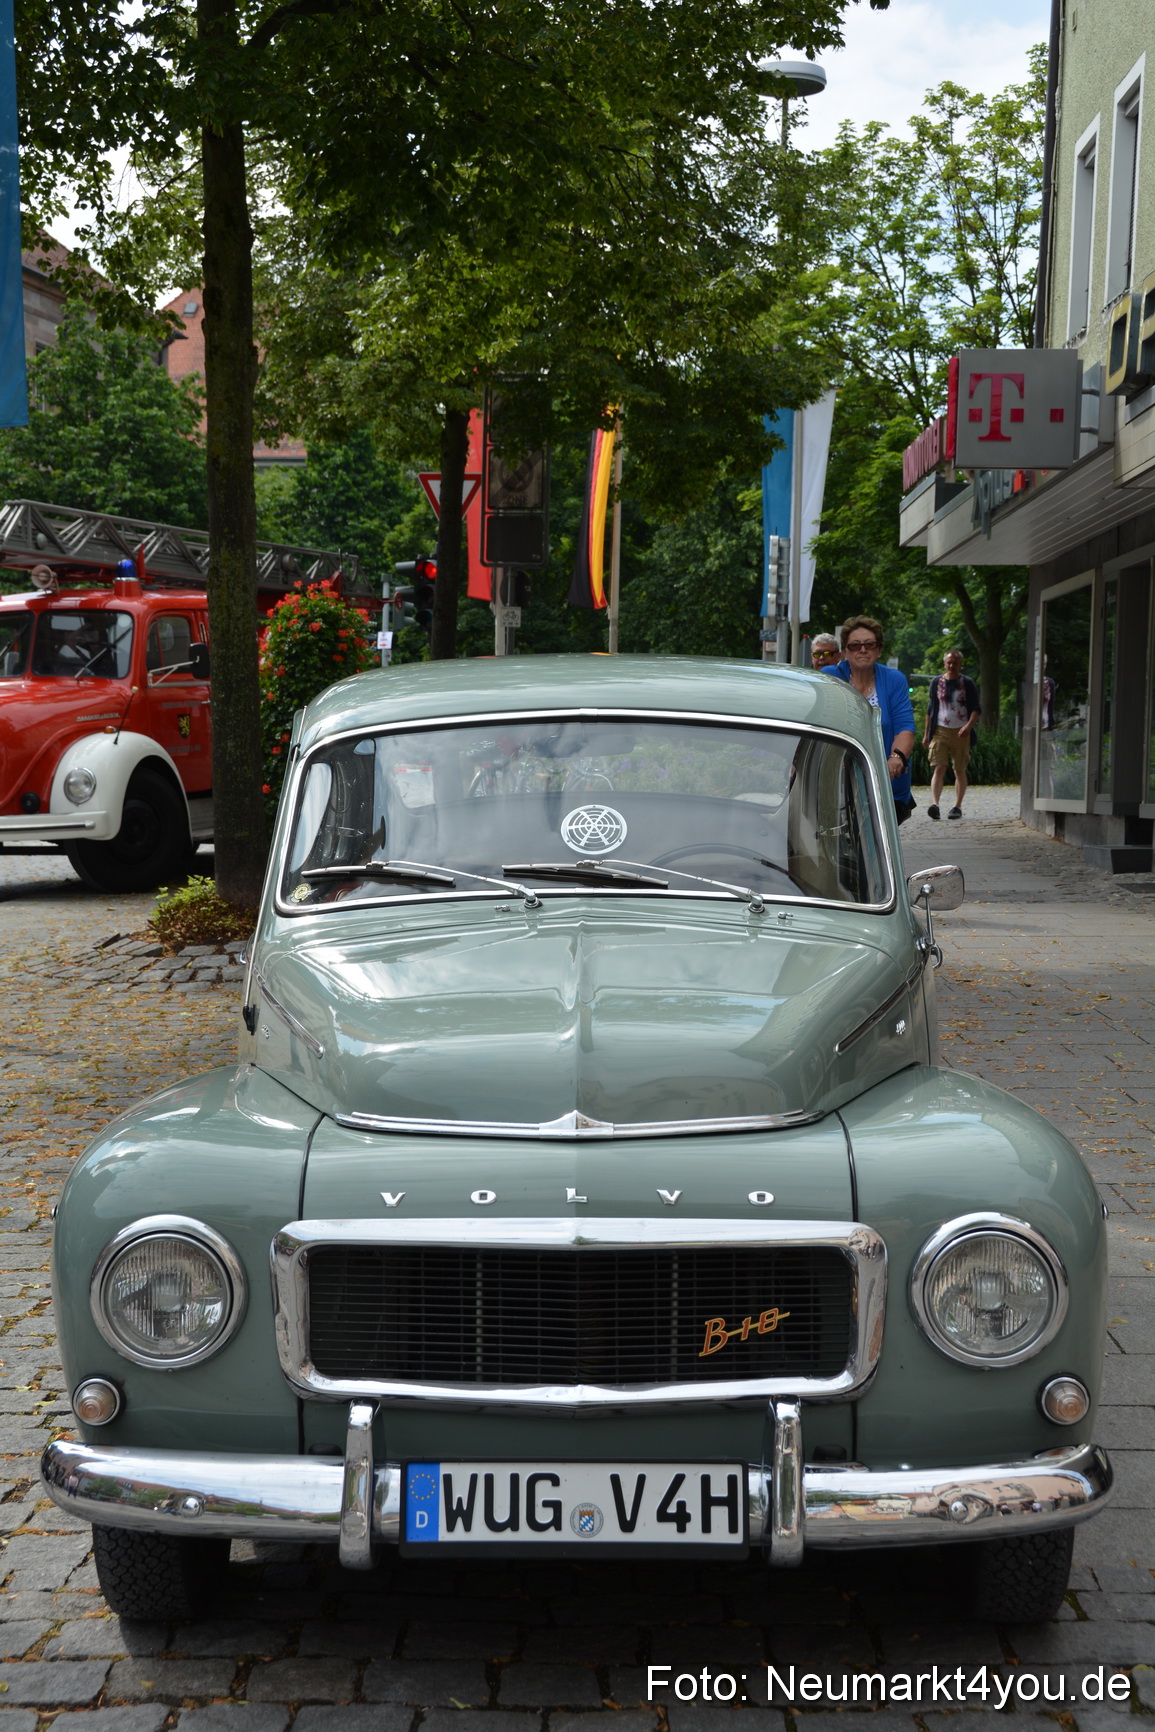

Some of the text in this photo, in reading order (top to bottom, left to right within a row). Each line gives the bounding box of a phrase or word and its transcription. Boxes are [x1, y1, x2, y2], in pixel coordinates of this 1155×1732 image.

[380, 1187, 775, 1208] VOLVO
[415, 1510, 429, 1529] D
[442, 1472, 563, 1533] WUG
[609, 1473, 739, 1534] V4H
